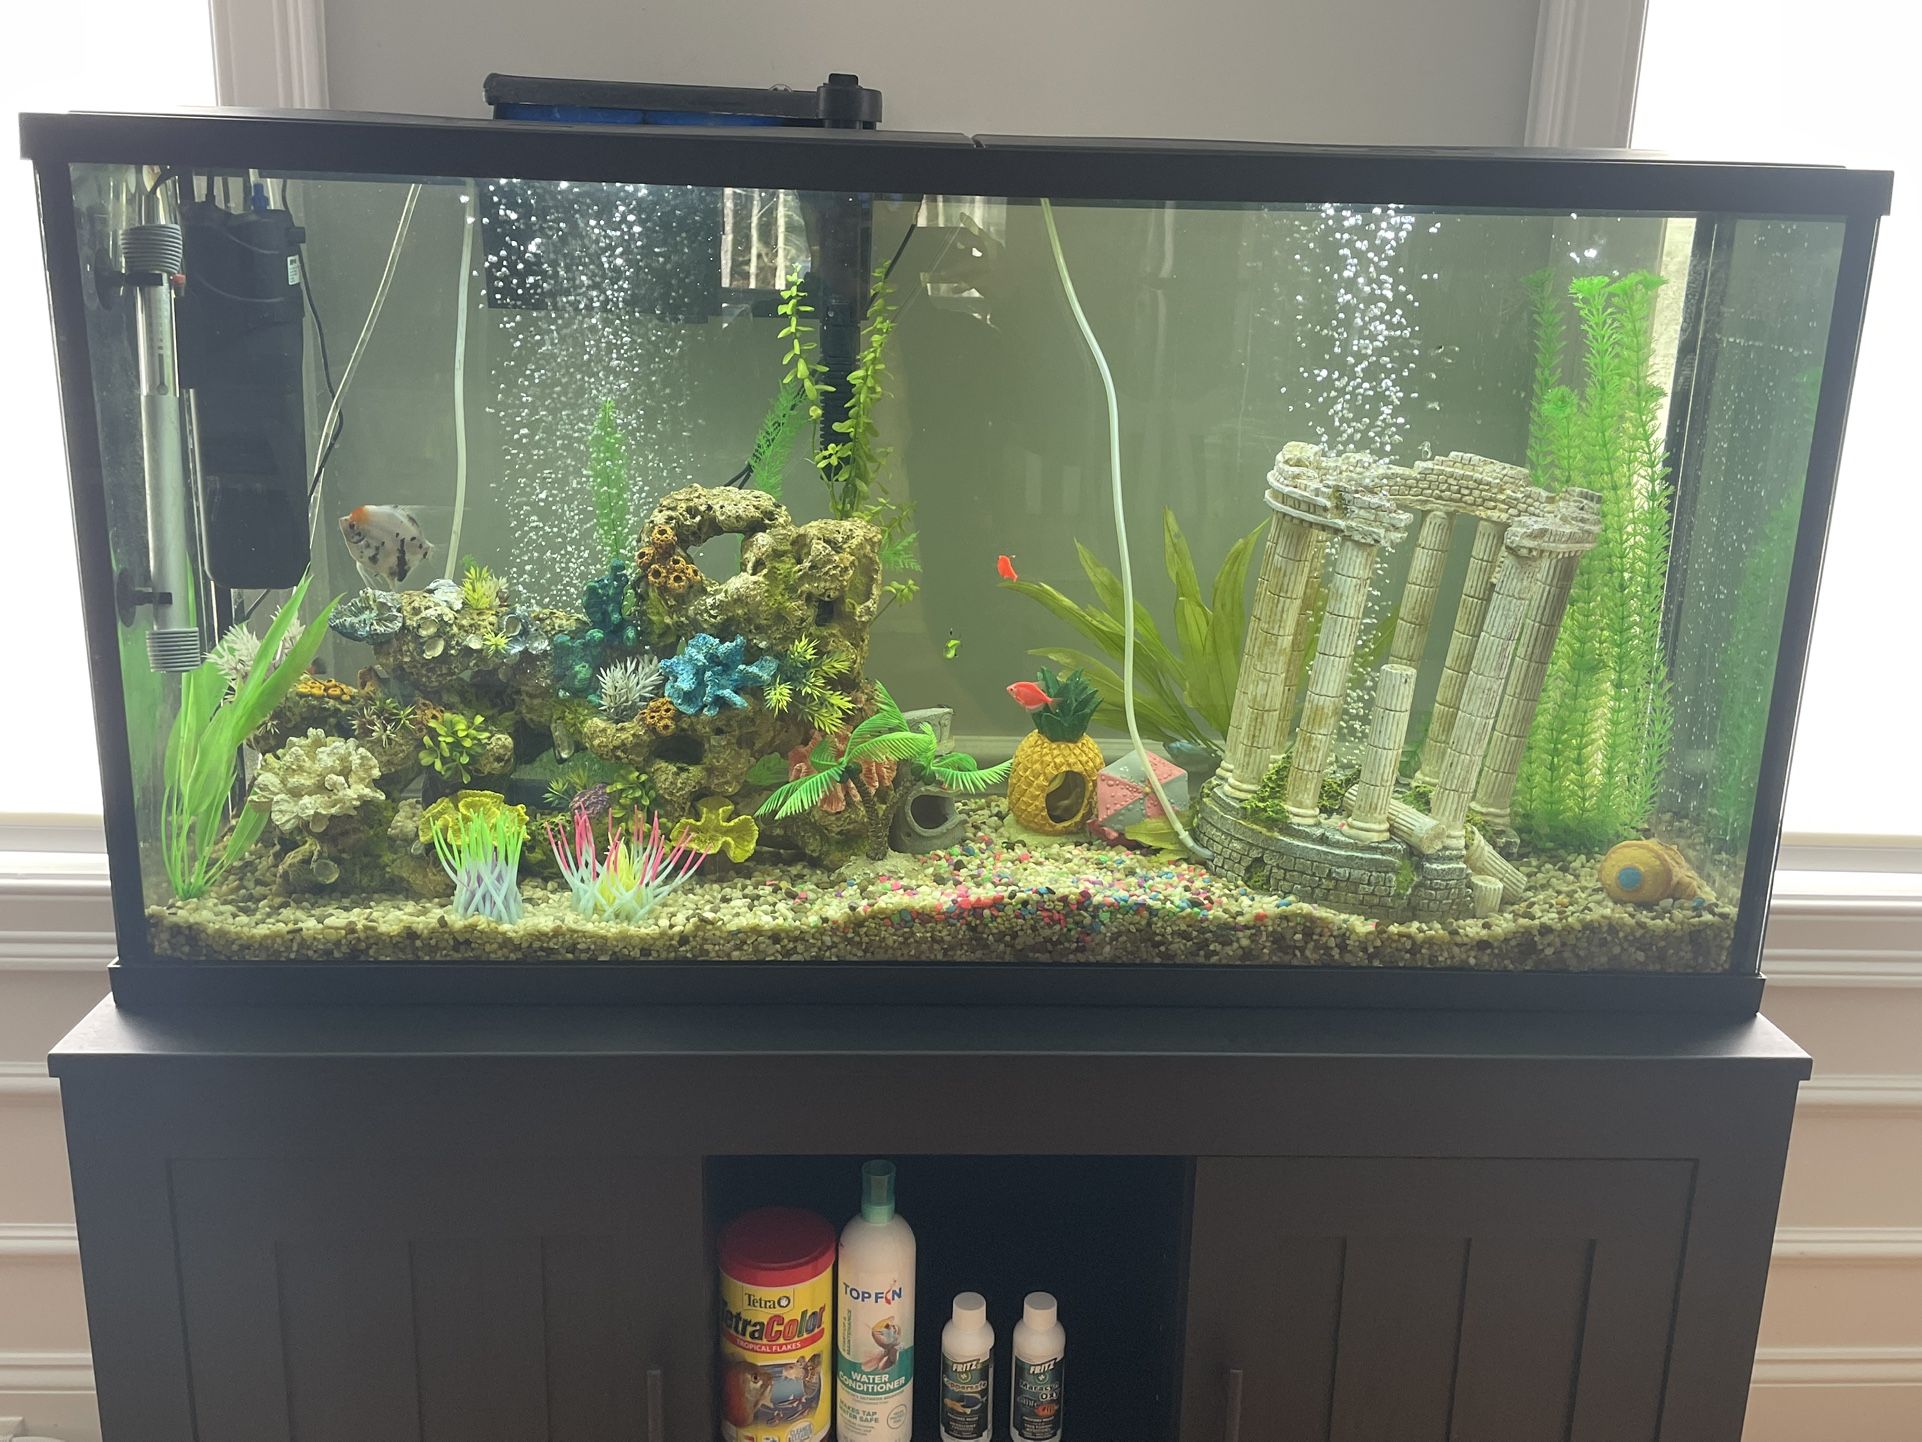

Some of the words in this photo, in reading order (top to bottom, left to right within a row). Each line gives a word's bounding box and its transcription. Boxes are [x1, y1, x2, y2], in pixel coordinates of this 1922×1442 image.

[843, 1282, 872, 1302] TOP
[745, 1293, 777, 1309] Tetra
[736, 1340, 771, 1352] TROPICAL
[772, 1342, 801, 1352] FLAKES
[952, 1361, 978, 1372] FRITZ
[1029, 1359, 1056, 1374] FRITZ
[839, 1371, 905, 1392] CONDITIONER
[851, 1371, 889, 1383] WATER
[859, 1415, 880, 1423] SAFE
